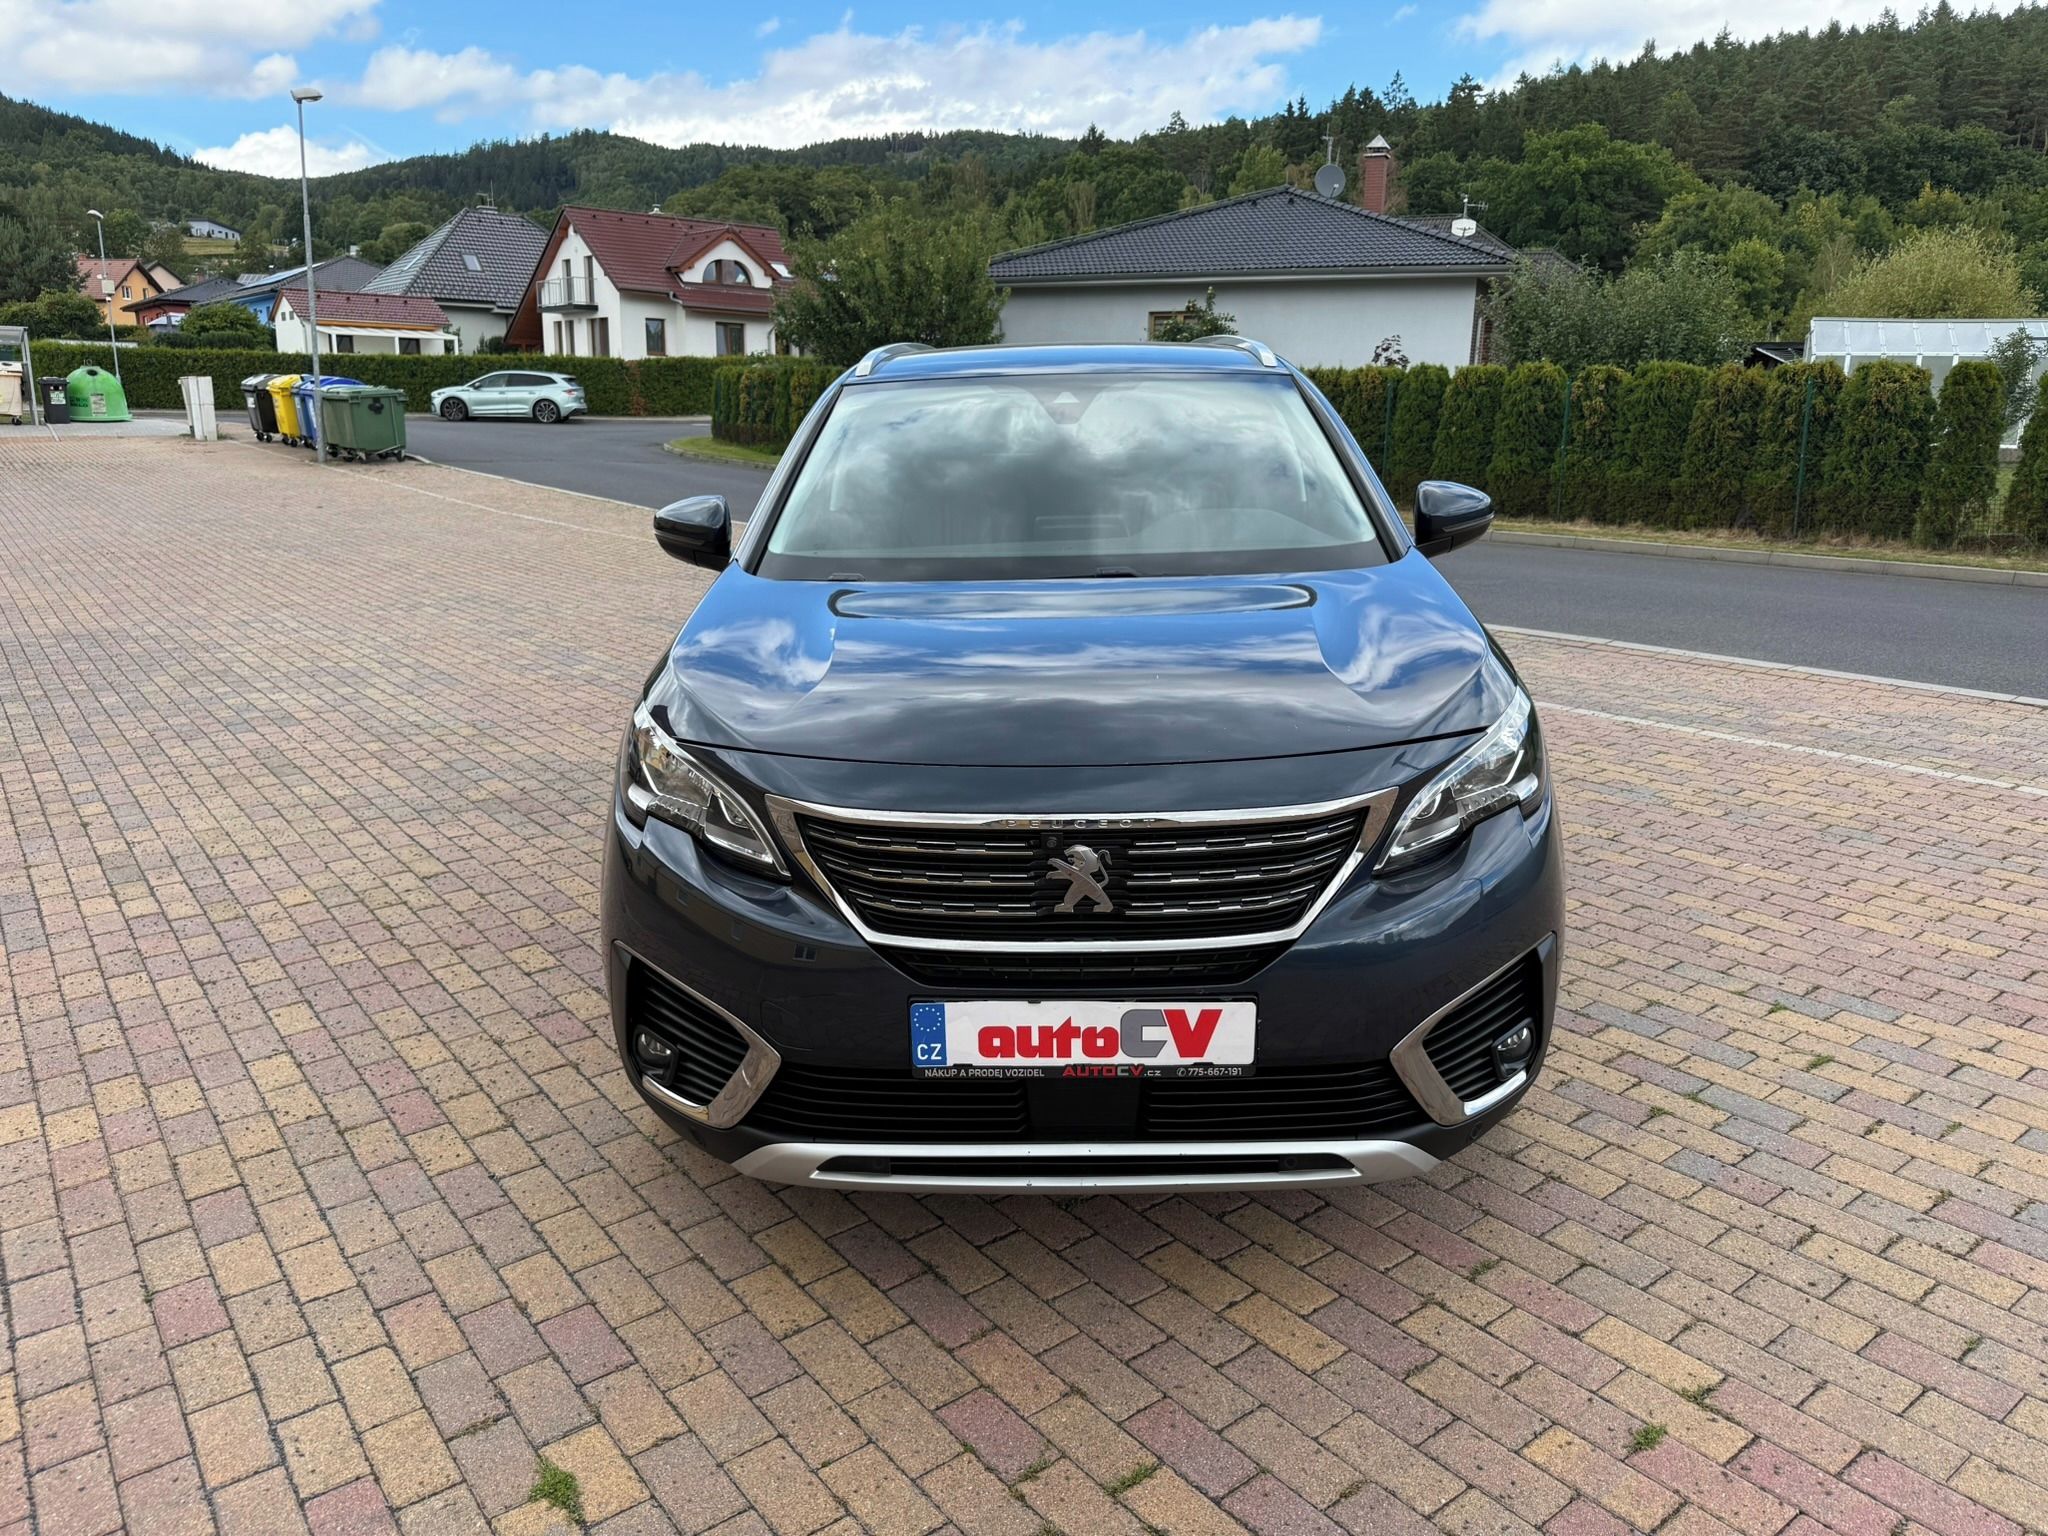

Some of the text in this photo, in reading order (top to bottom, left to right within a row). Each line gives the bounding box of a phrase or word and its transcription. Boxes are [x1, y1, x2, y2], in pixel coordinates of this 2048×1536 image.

[977, 1008, 1223, 1059] autoCV
[917, 1043, 942, 1061] CZ
[924, 1067, 1045, 1078] NÁKUP A PRODEJ VOZIDEL
[1187, 1067, 1242, 1077] 775-667-191
